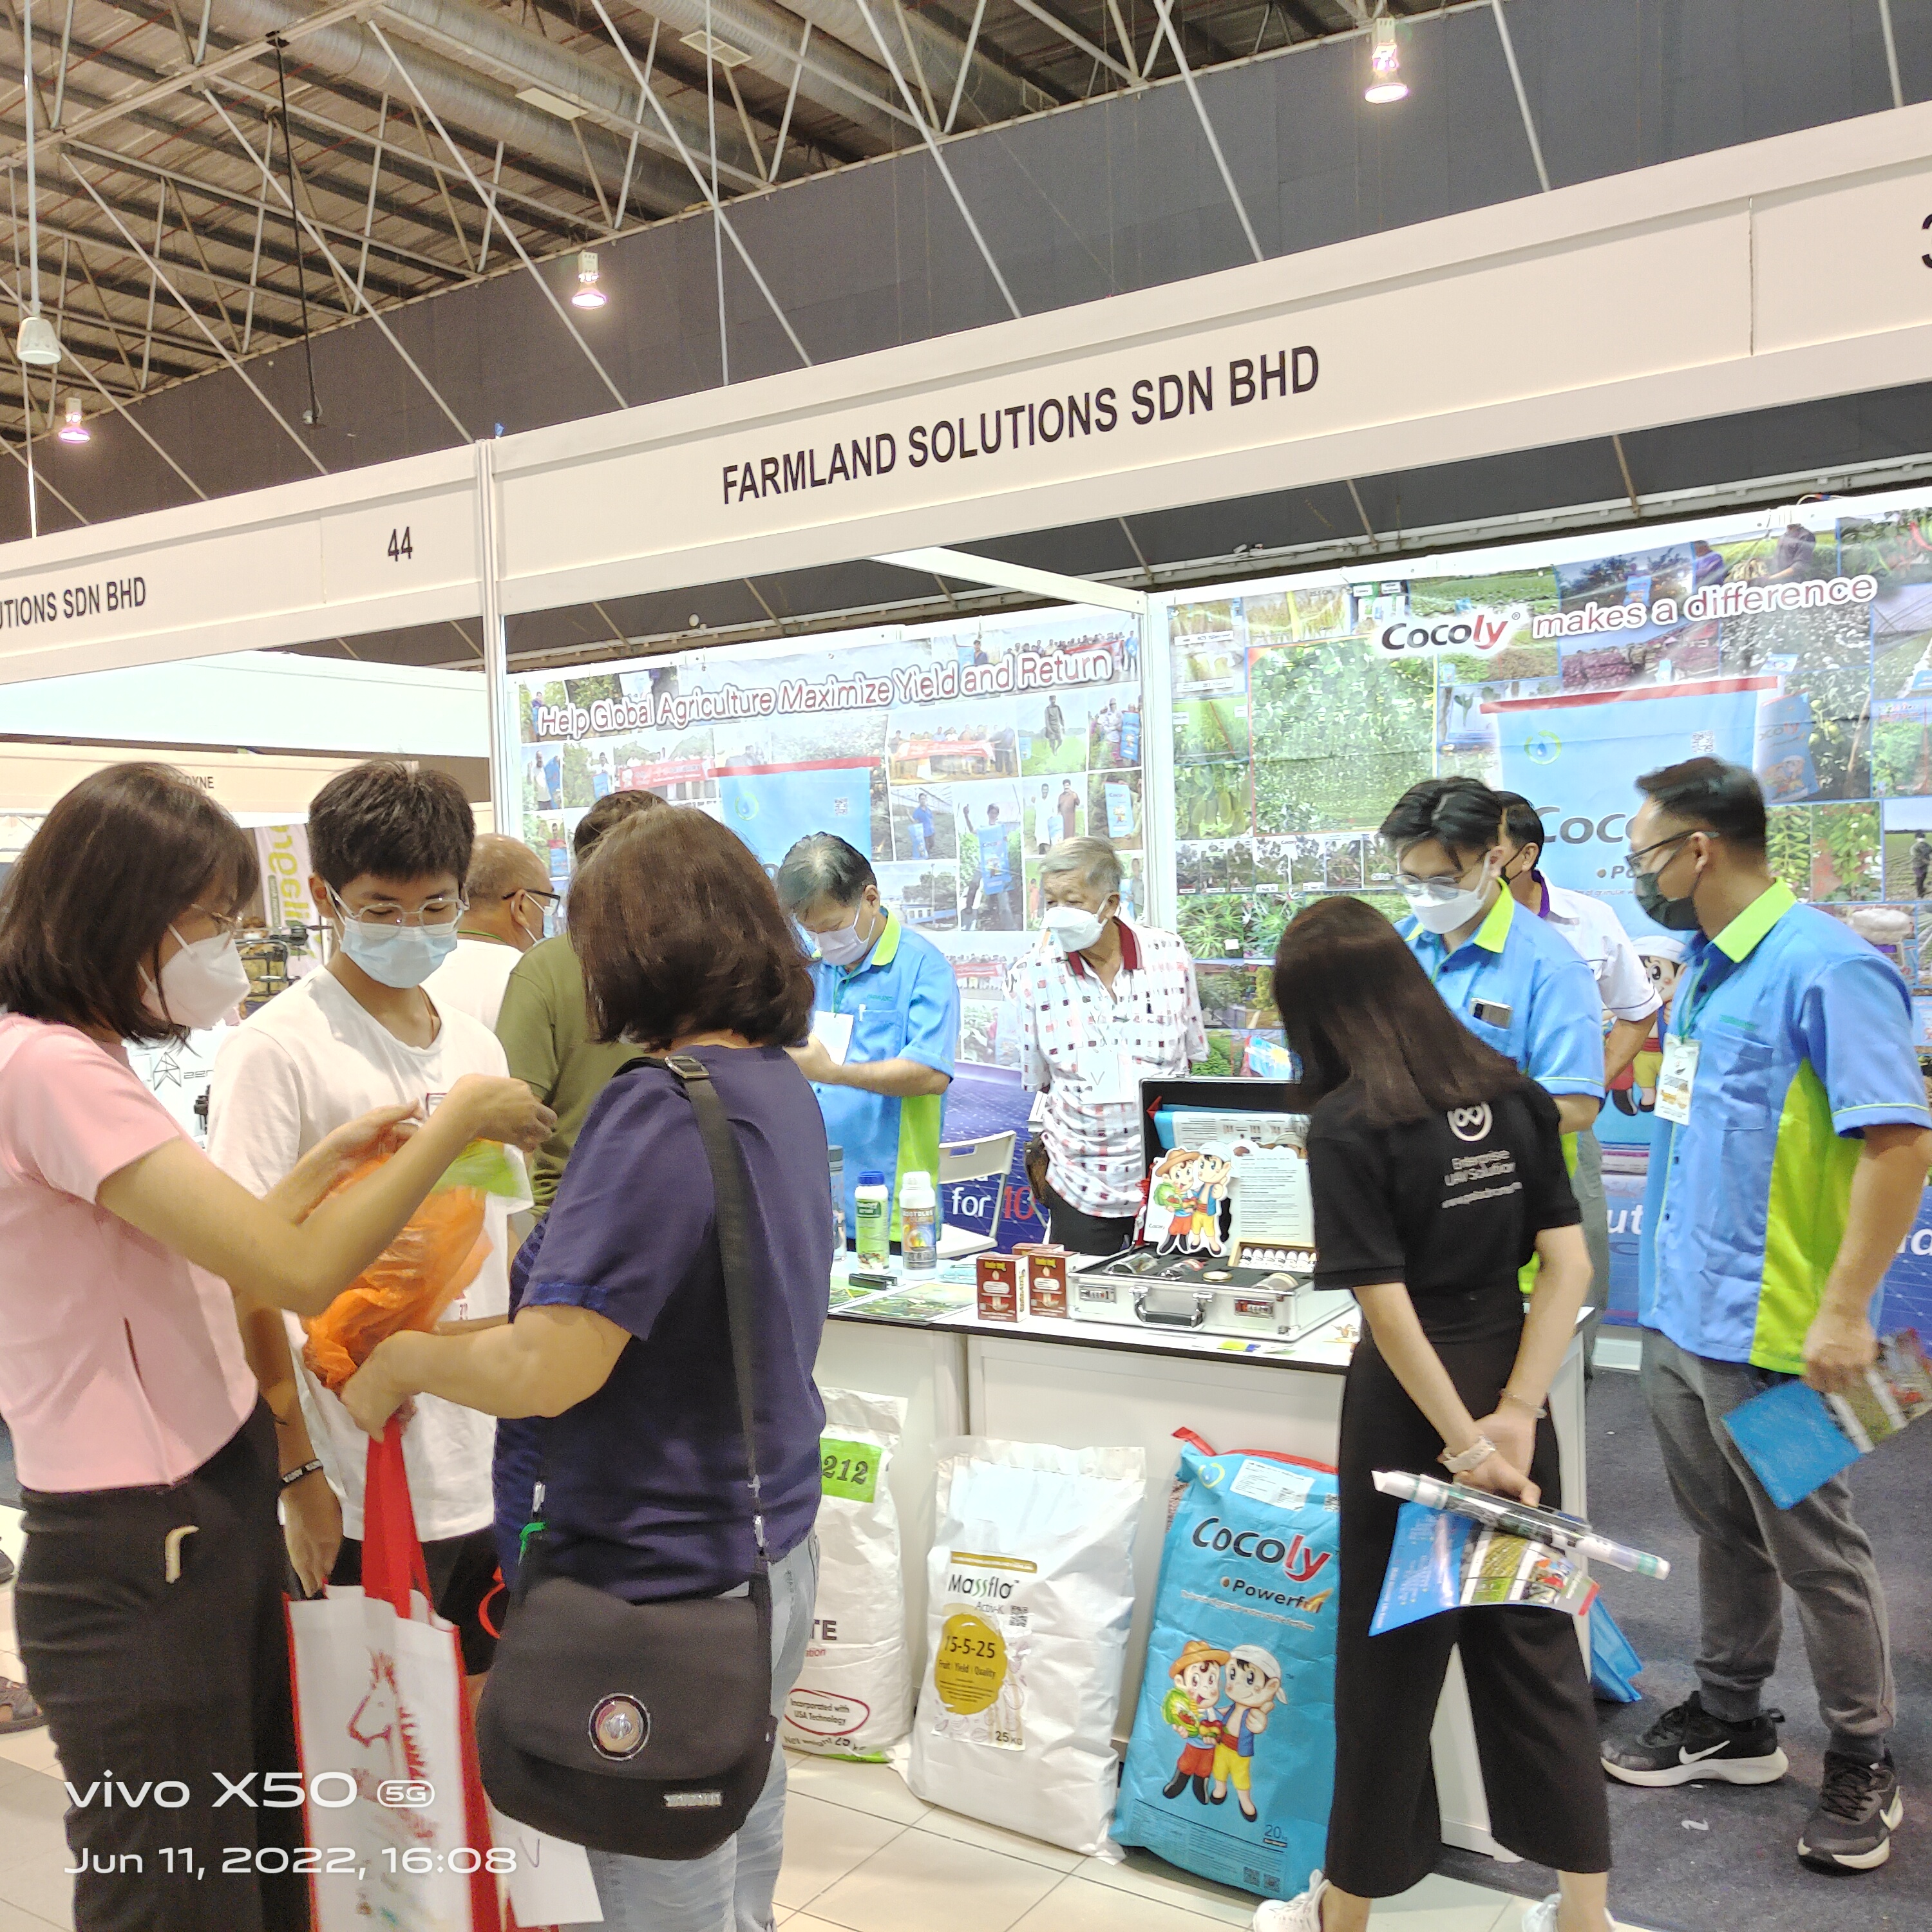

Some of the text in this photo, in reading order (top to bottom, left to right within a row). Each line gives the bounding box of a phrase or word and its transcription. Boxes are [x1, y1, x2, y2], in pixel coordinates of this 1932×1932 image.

[722, 345, 1320, 506] FARMLAND SOLUTIONS SDN BHD
[387, 526, 413, 563] 44
[0, 576, 146, 630] TIONS SDN BHD
[1381, 578, 1875, 650] Cocoly makes a difference
[541, 654, 1110, 739] Help Global Agriculture Maximize Yield and Return
[951, 1186, 992, 1217] for
[822, 1455, 868, 1485] 212
[1192, 1517, 1331, 1582] Cocoly
[947, 1574, 1015, 1599] Massflo
[945, 1635, 996, 1659] 15-5-25
[793, 1710, 846, 1726] USA Technology
